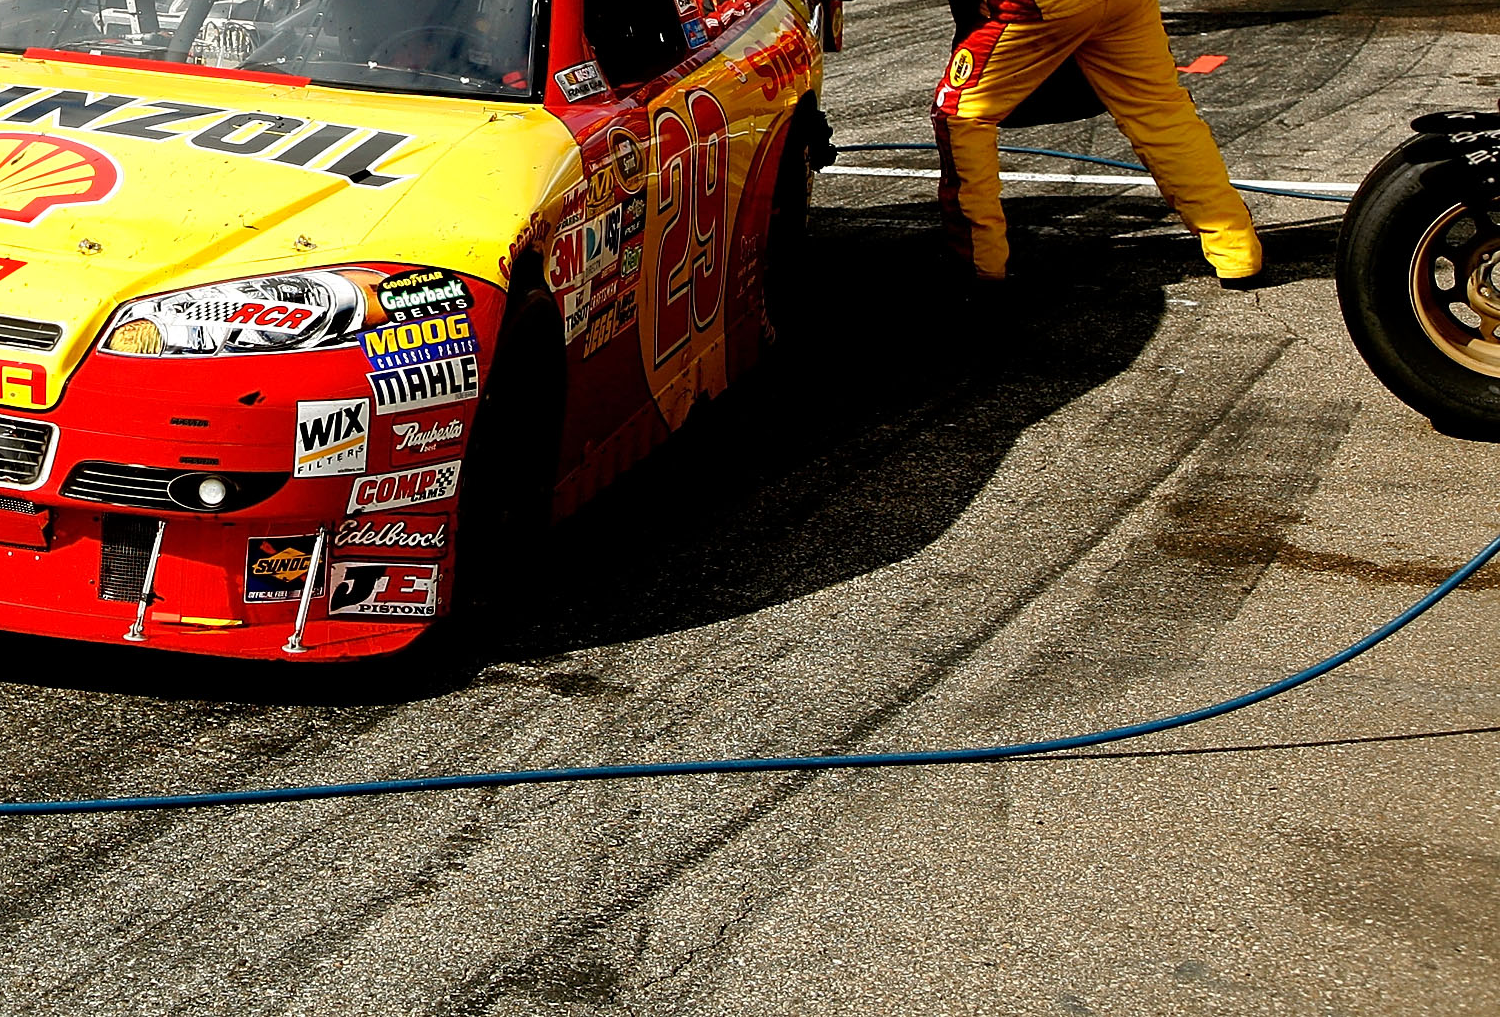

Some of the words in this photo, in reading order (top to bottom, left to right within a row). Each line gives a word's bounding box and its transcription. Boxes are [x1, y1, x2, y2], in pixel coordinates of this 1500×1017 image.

[568, 84, 589, 97] RACE
[654, 89, 730, 371] 29
[550, 228, 583, 288] 3M
[383, 270, 444, 290] GOODYEAR
[380, 280, 466, 311] Gatorback
[394, 298, 468, 322] BELTS
[228, 302, 313, 330] RCR
[365, 313, 470, 358] MOOG
[378, 348, 431, 369] CHASSIS
[438, 339, 474, 357] PARTS
[370, 356, 477, 406] MAHLE
[299, 401, 366, 452] WIX
[297, 444, 365, 475] FILTERS
[355, 469, 437, 506] COMP
[410, 486, 448, 503] CAMS
[335, 519, 446, 548] Edelbrock
[255, 556, 311, 576] SUNOC
[330, 565, 434, 612] JE
[358, 604, 435, 615] PISTONS
